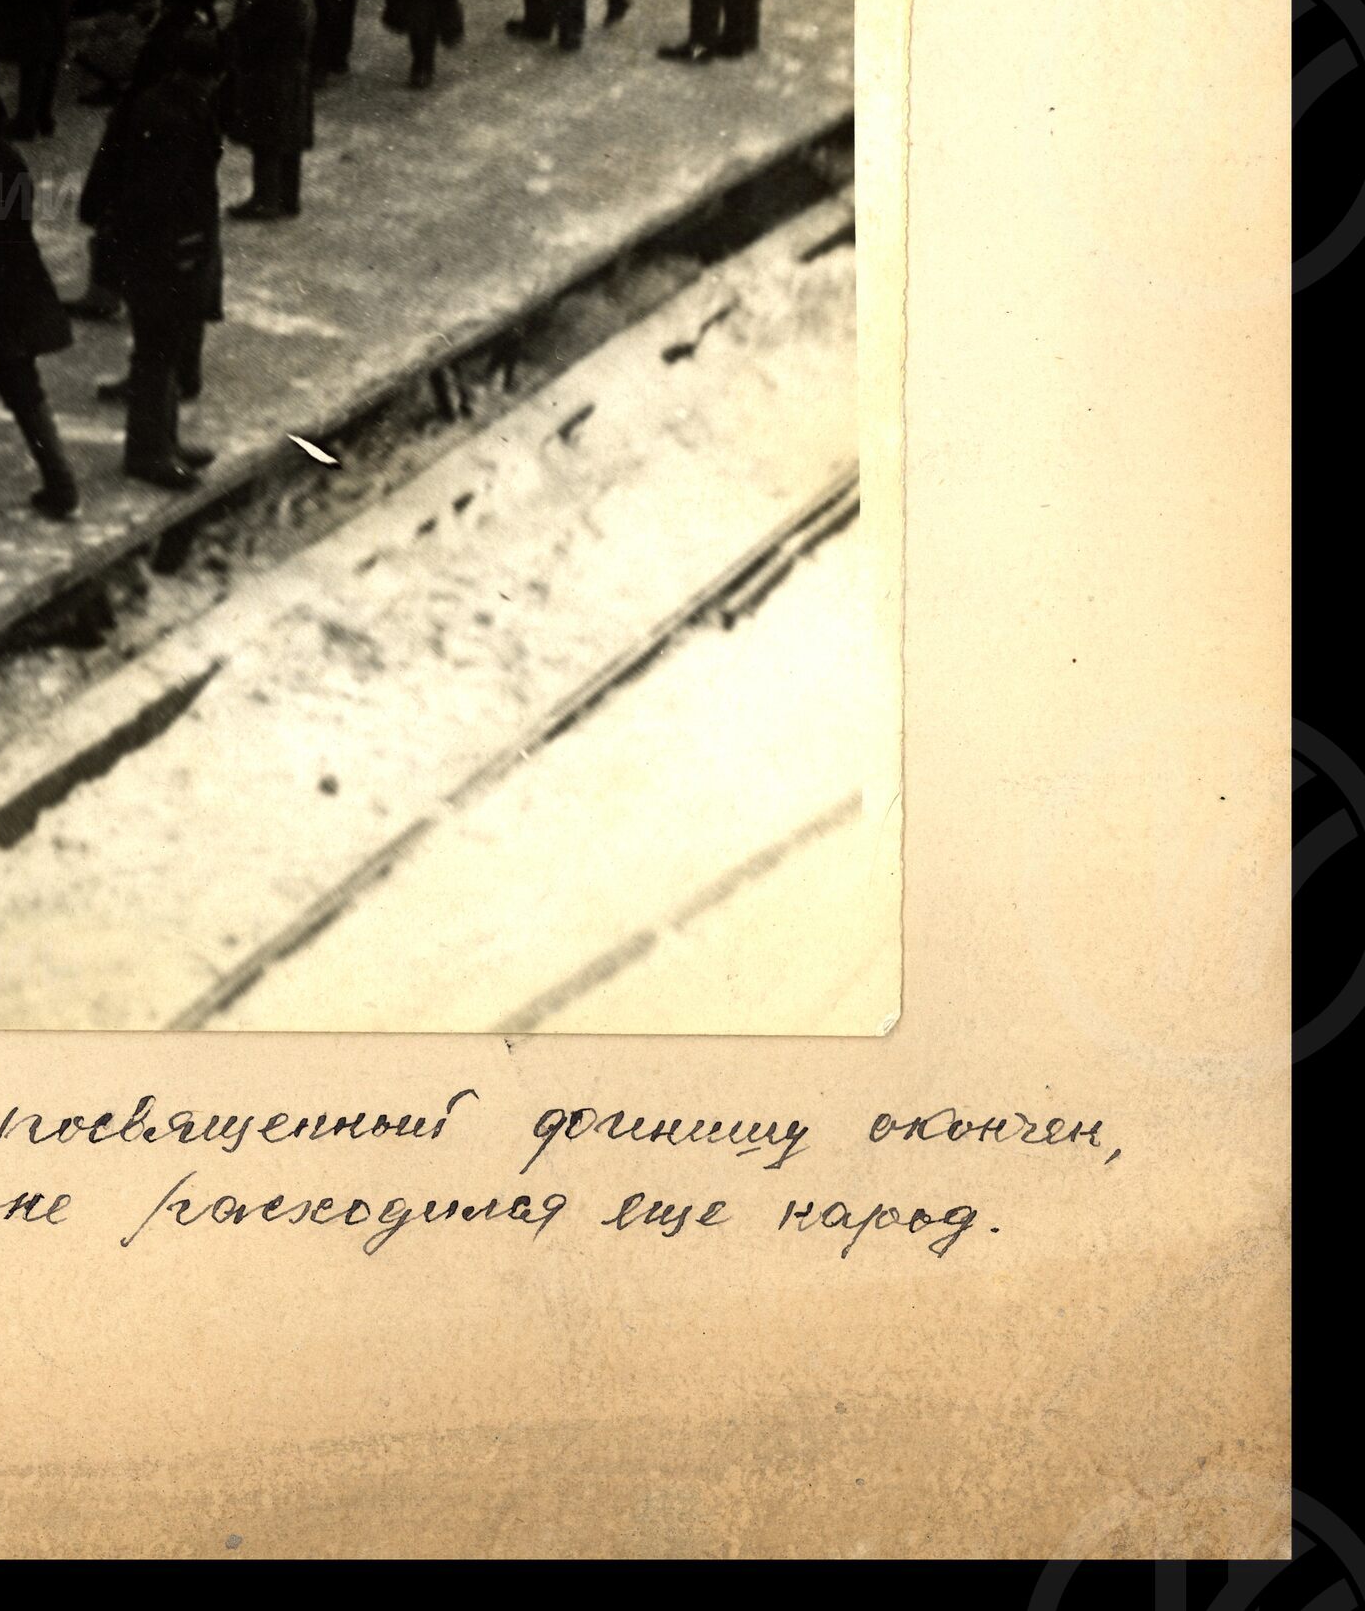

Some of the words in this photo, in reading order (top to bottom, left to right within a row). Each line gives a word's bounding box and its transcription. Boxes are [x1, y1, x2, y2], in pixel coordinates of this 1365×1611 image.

[120, 1170, 568, 1256] расходился
[601, 1191, 734, 1239] еще
[778, 1200, 1000, 1259] народ.
